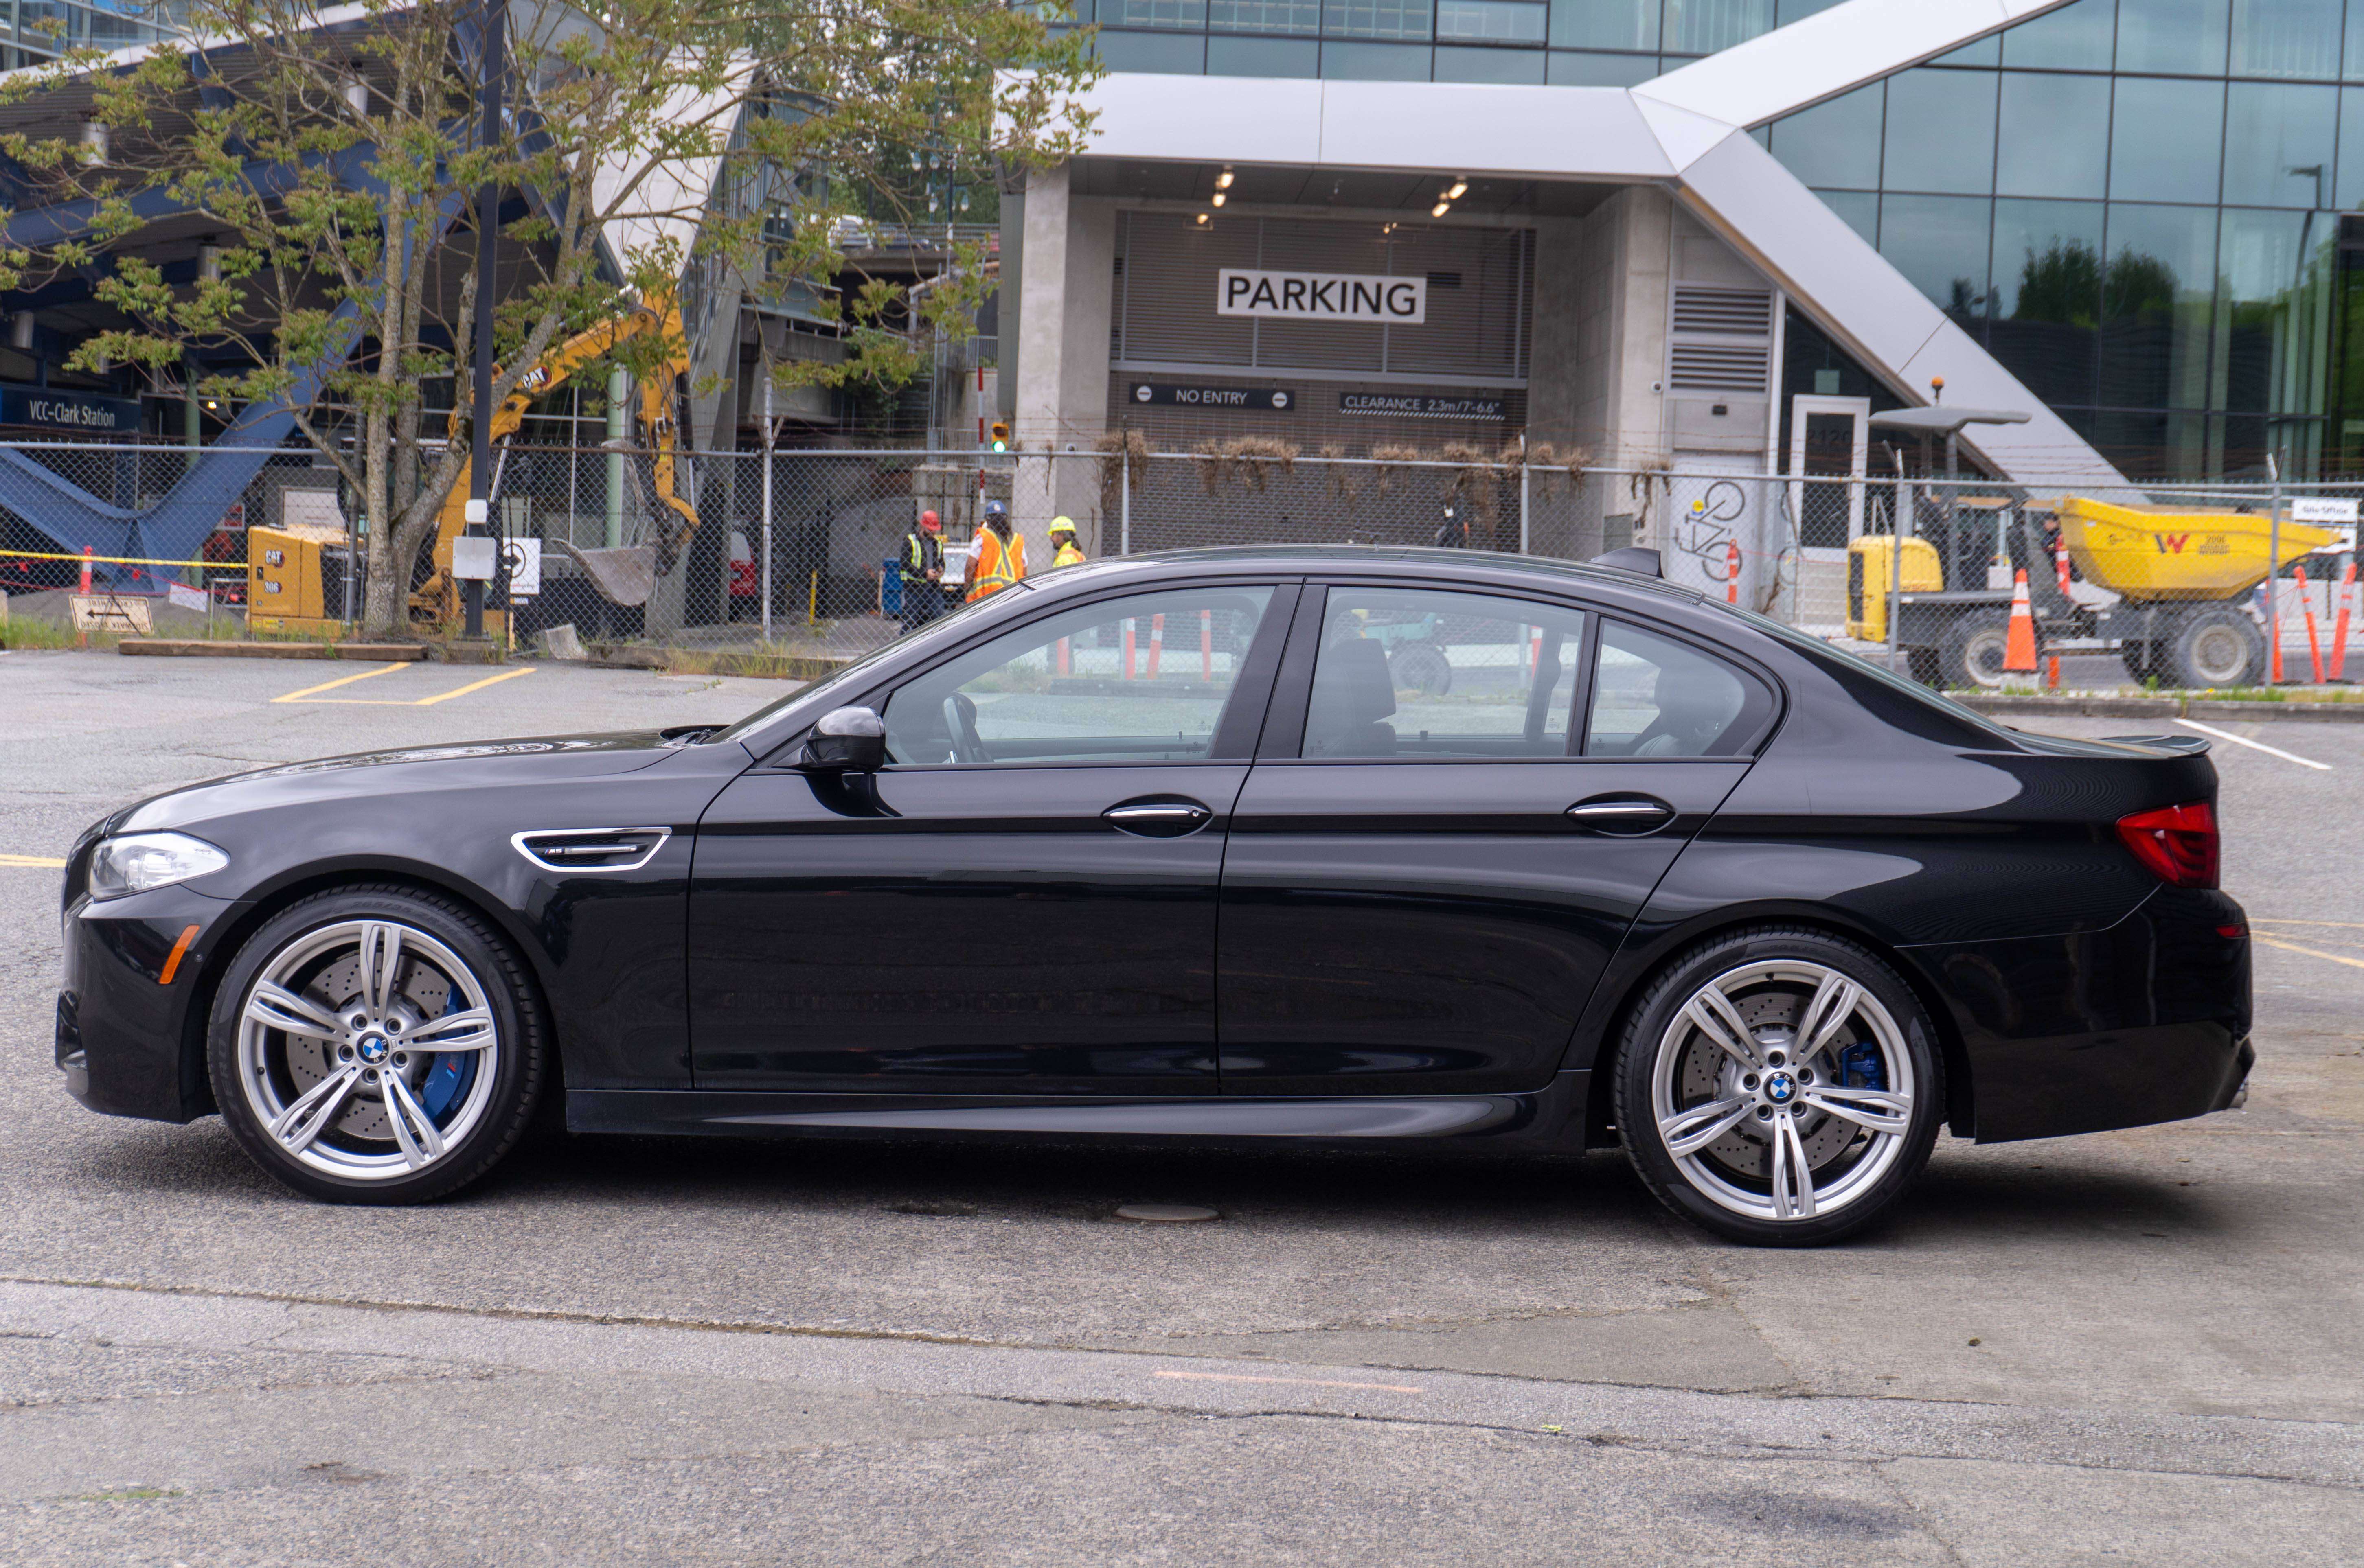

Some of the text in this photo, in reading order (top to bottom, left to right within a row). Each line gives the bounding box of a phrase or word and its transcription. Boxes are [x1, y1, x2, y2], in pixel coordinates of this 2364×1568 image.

[1227, 276, 1417, 316] PARKING
[521, 367, 546, 389] CAT
[1175, 389, 1248, 405] NO ENTRY
[1345, 396, 1421, 411] CLEARANCE
[81, 405, 115, 427] Station
[266, 550, 282, 565] CAT
[265, 581, 280, 594] 306
[373, 1039, 388, 1063] BMW
[1773, 1073, 1795, 1091] BMW
